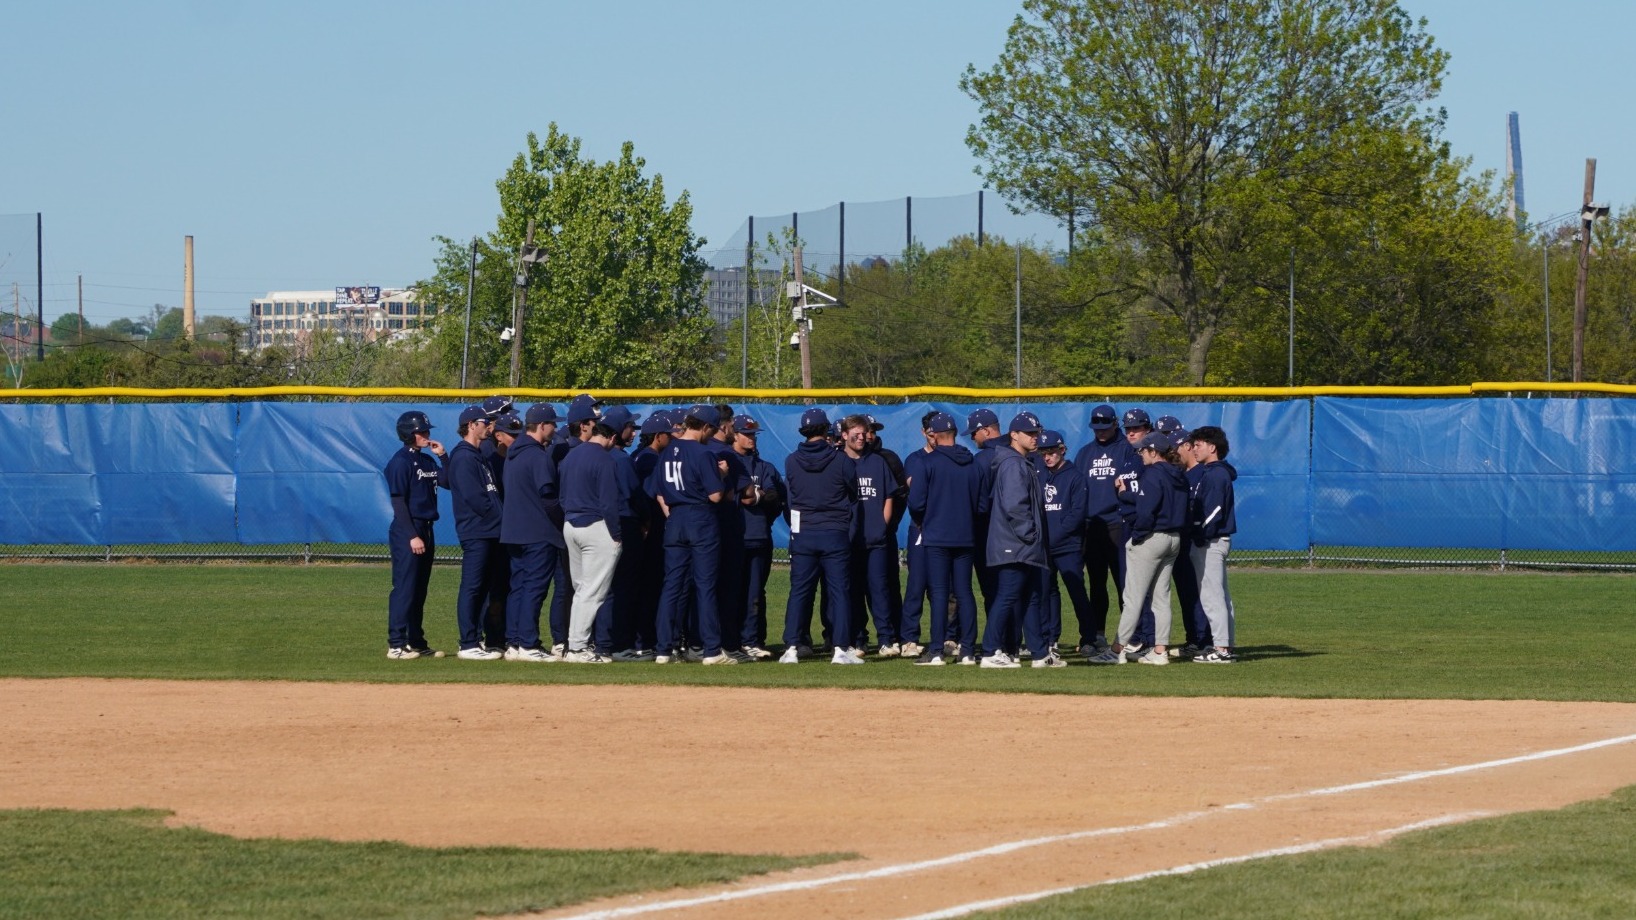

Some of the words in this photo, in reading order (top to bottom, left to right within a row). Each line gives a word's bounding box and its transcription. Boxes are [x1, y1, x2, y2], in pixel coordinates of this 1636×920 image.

[1093, 458, 1113, 467] SAINT
[665, 461, 685, 491] 41
[1089, 467, 1116, 477] PETER'S
[858, 477, 872, 486] INT
